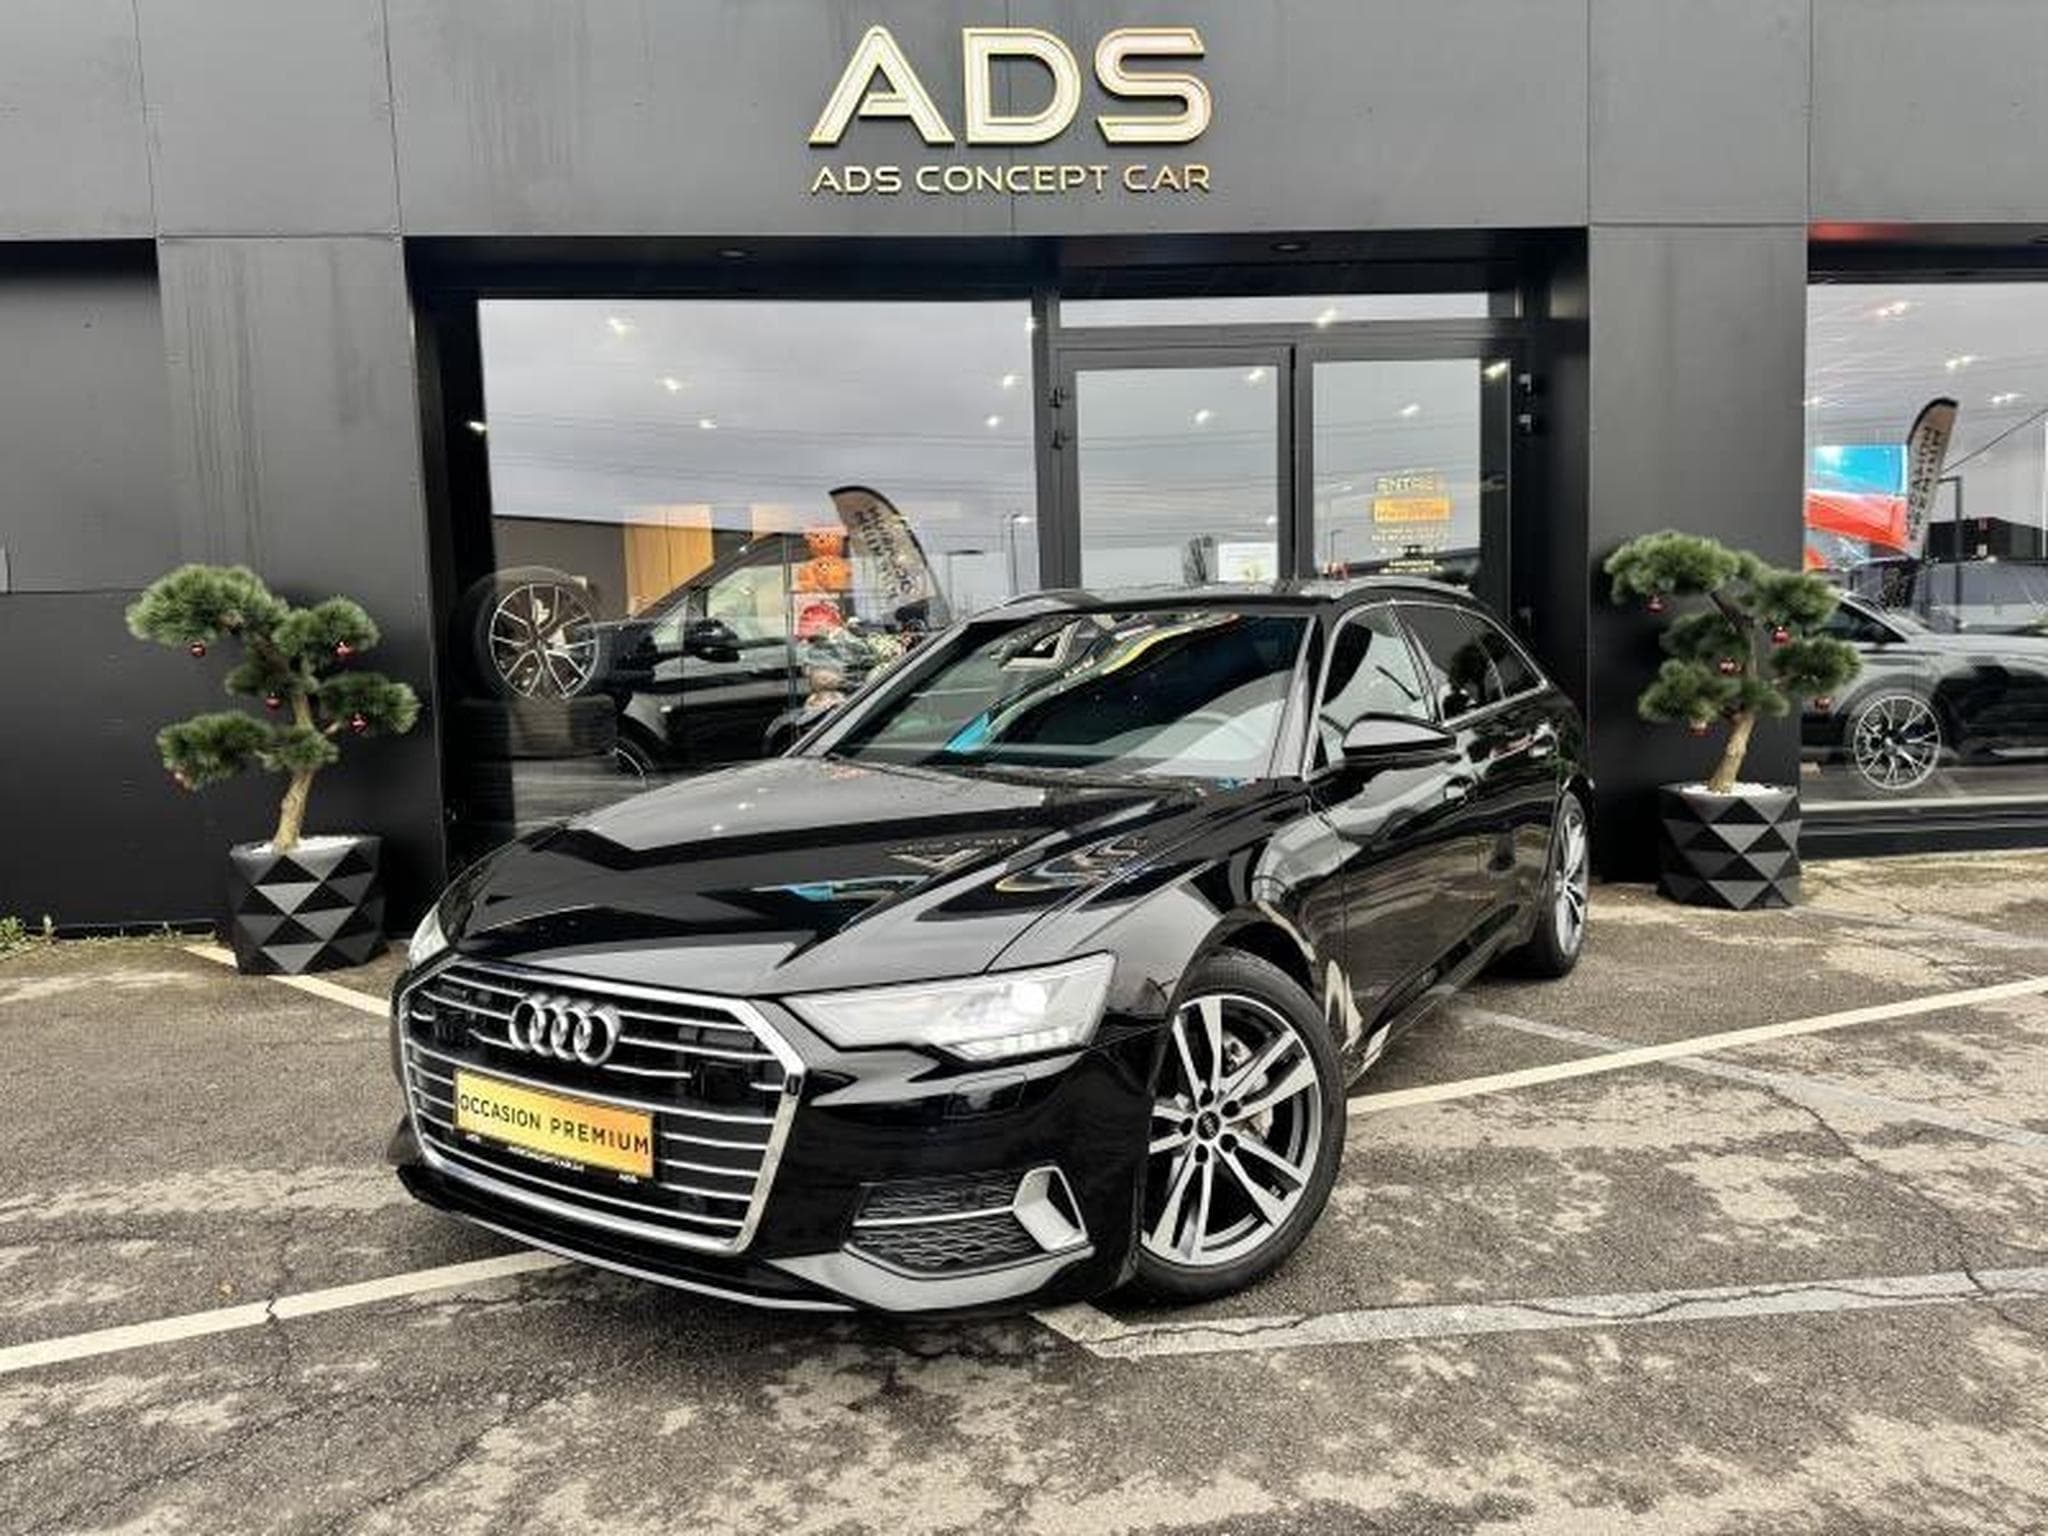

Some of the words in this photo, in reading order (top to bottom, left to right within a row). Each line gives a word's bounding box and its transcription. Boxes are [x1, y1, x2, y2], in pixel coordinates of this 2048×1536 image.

[808, 24, 1212, 145] ADS
[811, 165, 901, 194] ADS
[915, 165, 1110, 193] CONCEPT
[1123, 164, 1211, 193] CAR
[459, 1093, 542, 1130] OCCASION
[550, 1117, 650, 1156] PREMIUM
